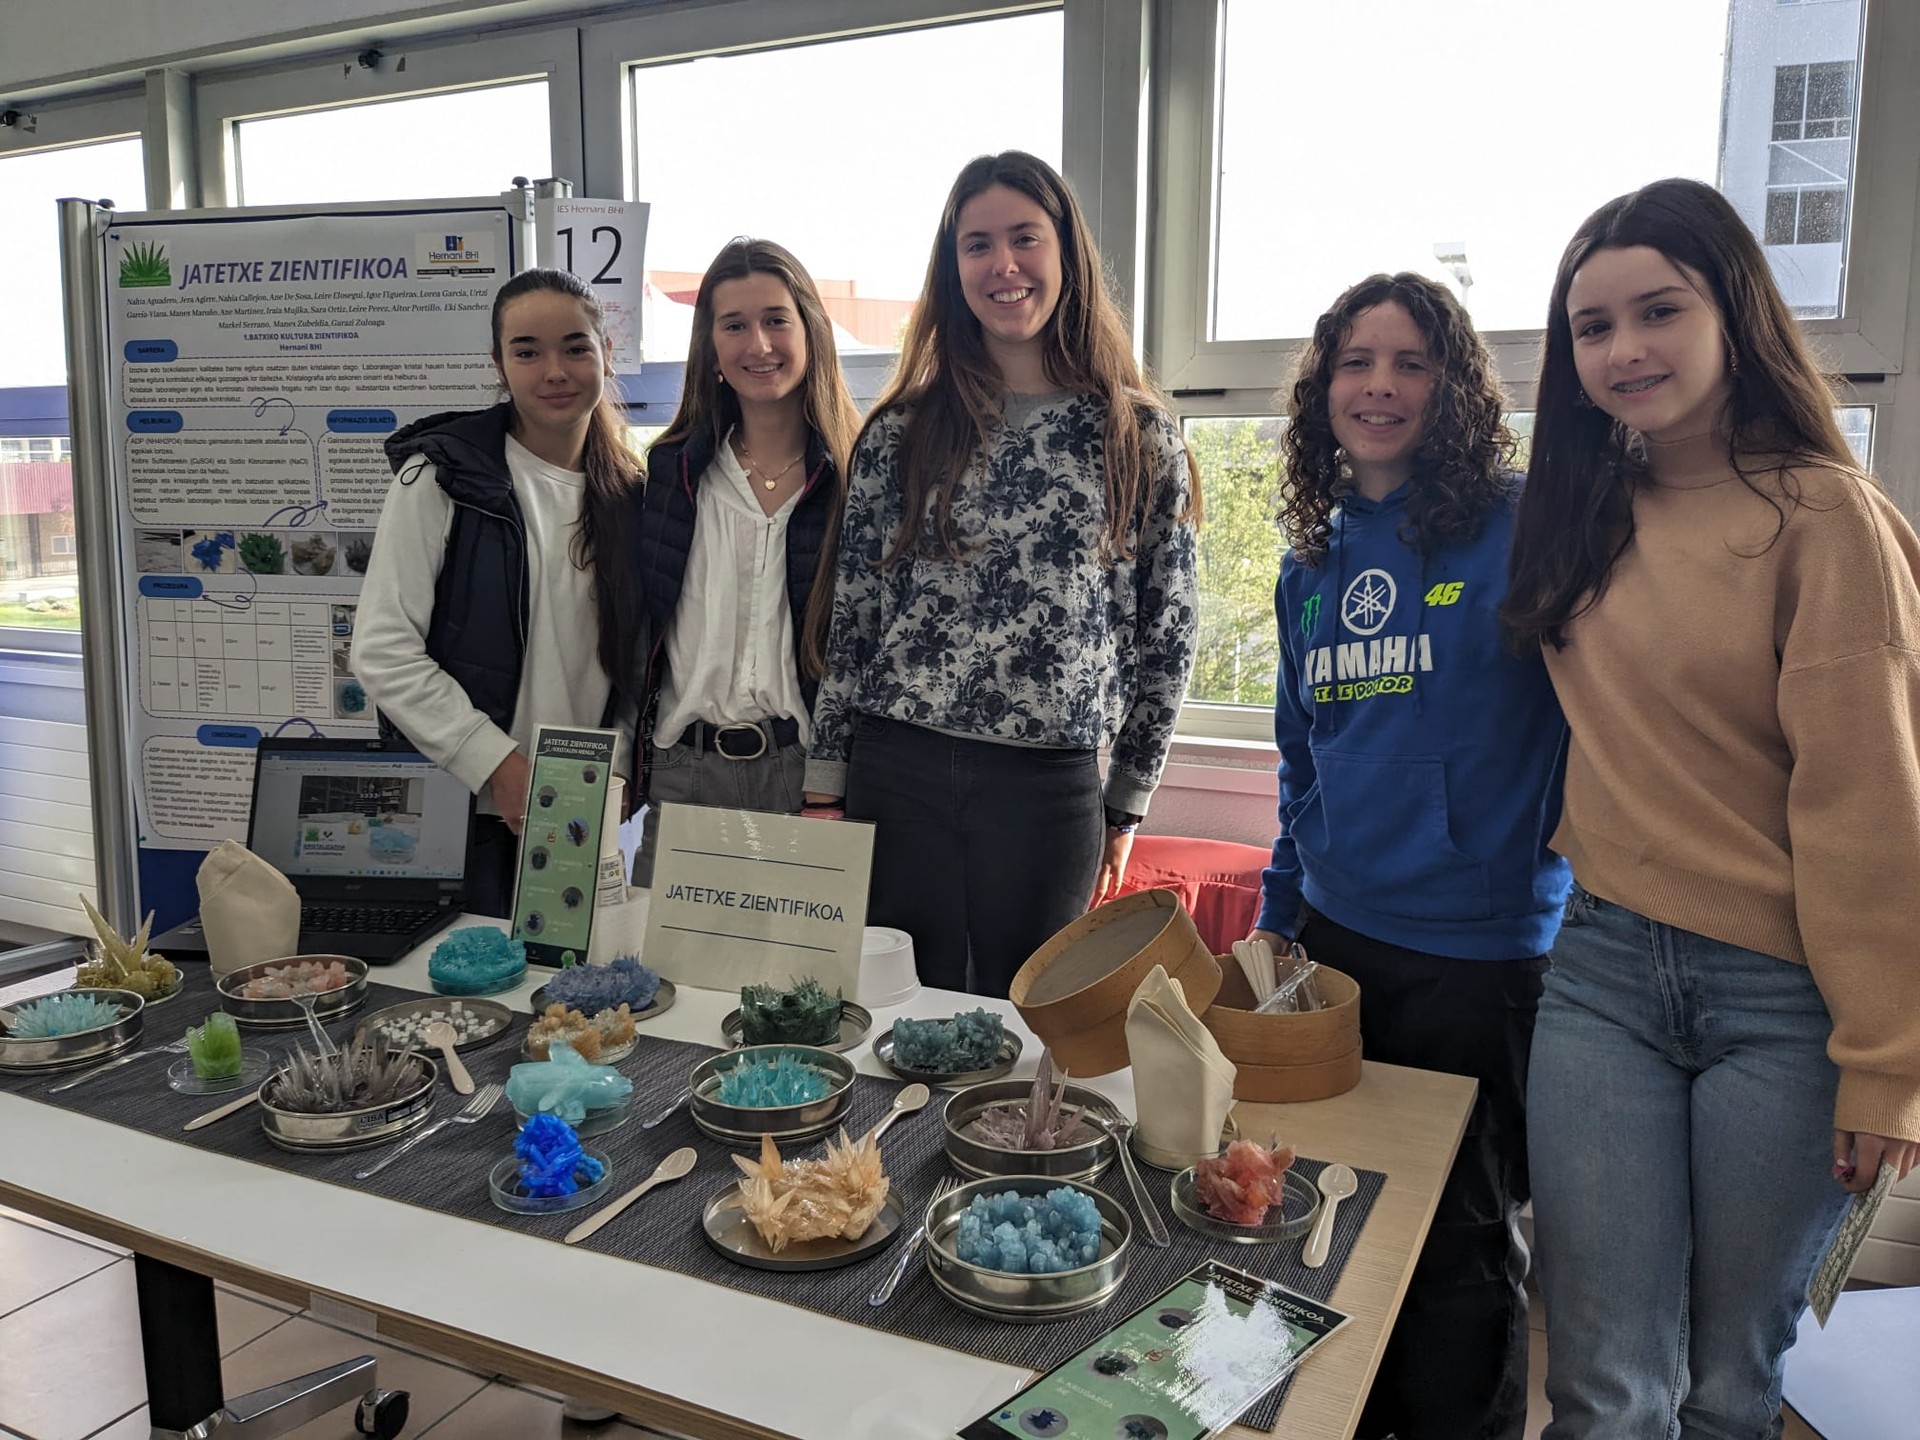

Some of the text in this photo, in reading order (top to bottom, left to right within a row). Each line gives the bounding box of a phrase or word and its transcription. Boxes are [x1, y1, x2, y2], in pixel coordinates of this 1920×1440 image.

[557, 205, 624, 215] IES Hernani BHI
[429, 251, 479, 260] Hernani BHI
[557, 226, 622, 284] 12
[179, 257, 408, 290] JATETXE ZIENTIFIKOA
[280, 331, 313, 340] KULTURA
[314, 330, 358, 340] ZIENTIFIKOA
[280, 342, 321, 351] Hernani BHI
[1424, 582, 1464, 606] 46
[1305, 634, 1433, 686] YAMAHA
[544, 738, 608, 750] JATETXE ZIENTIFIKOA
[666, 884, 845, 922] JATETXE ZIENTIFIKOA
[361, 1113, 383, 1124] CISA
[1206, 1272, 1326, 1324] JATETXE ZIENTIFIKOA
